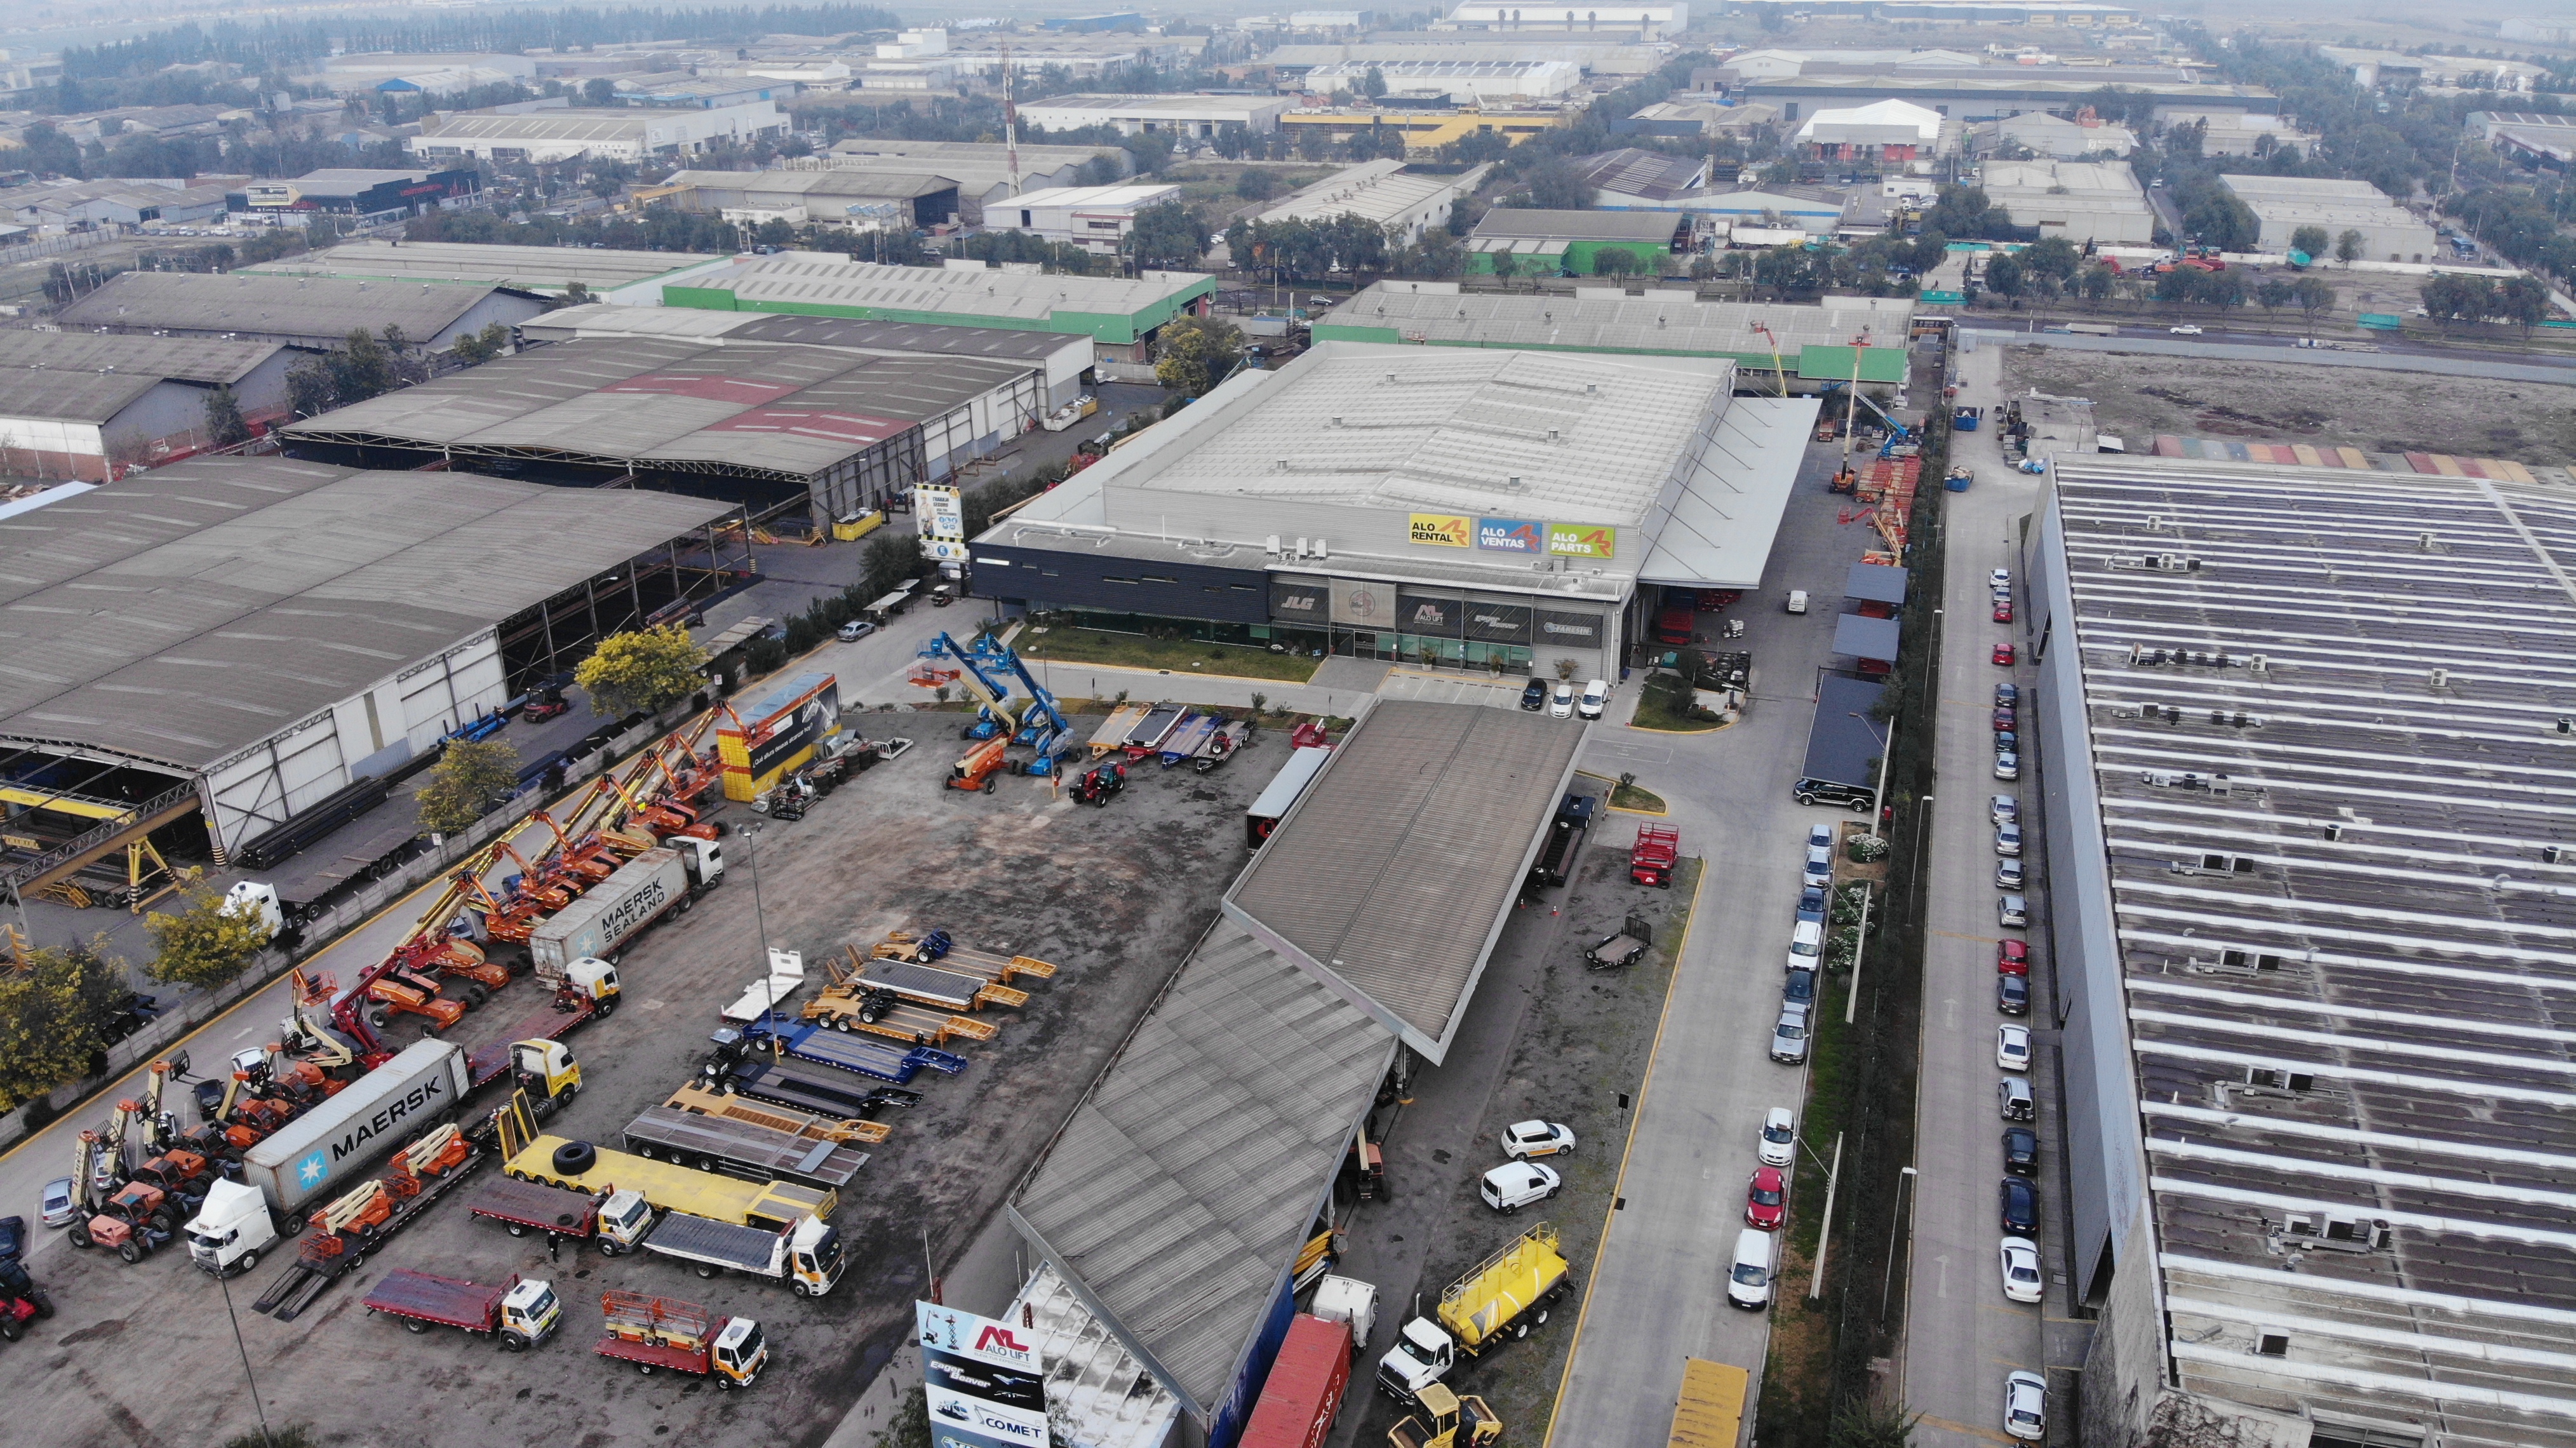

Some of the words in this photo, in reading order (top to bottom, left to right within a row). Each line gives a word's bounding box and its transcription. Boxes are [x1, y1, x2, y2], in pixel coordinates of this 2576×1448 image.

[1412, 523, 1435, 531] ALO
[1481, 528, 1505, 537] ALO
[1412, 532, 1452, 542] RENTAL
[1481, 537, 1525, 548] VENTAS
[1552, 532, 1577, 542] ALO
[1552, 542, 1591, 553] PARTS
[1281, 596, 1315, 610] JLG
[1556, 625, 1591, 635] FARESIN
[602, 876, 663, 930] MAERSK
[604, 891, 666, 942] SEALAND
[332, 1076, 442, 1162] MAERSK
[986, 1344, 1007, 1356] ALO
[1010, 1349, 1030, 1362] LIFT
[930, 1359, 964, 1374] Eager
[949, 1372, 991, 1388] Beaver
